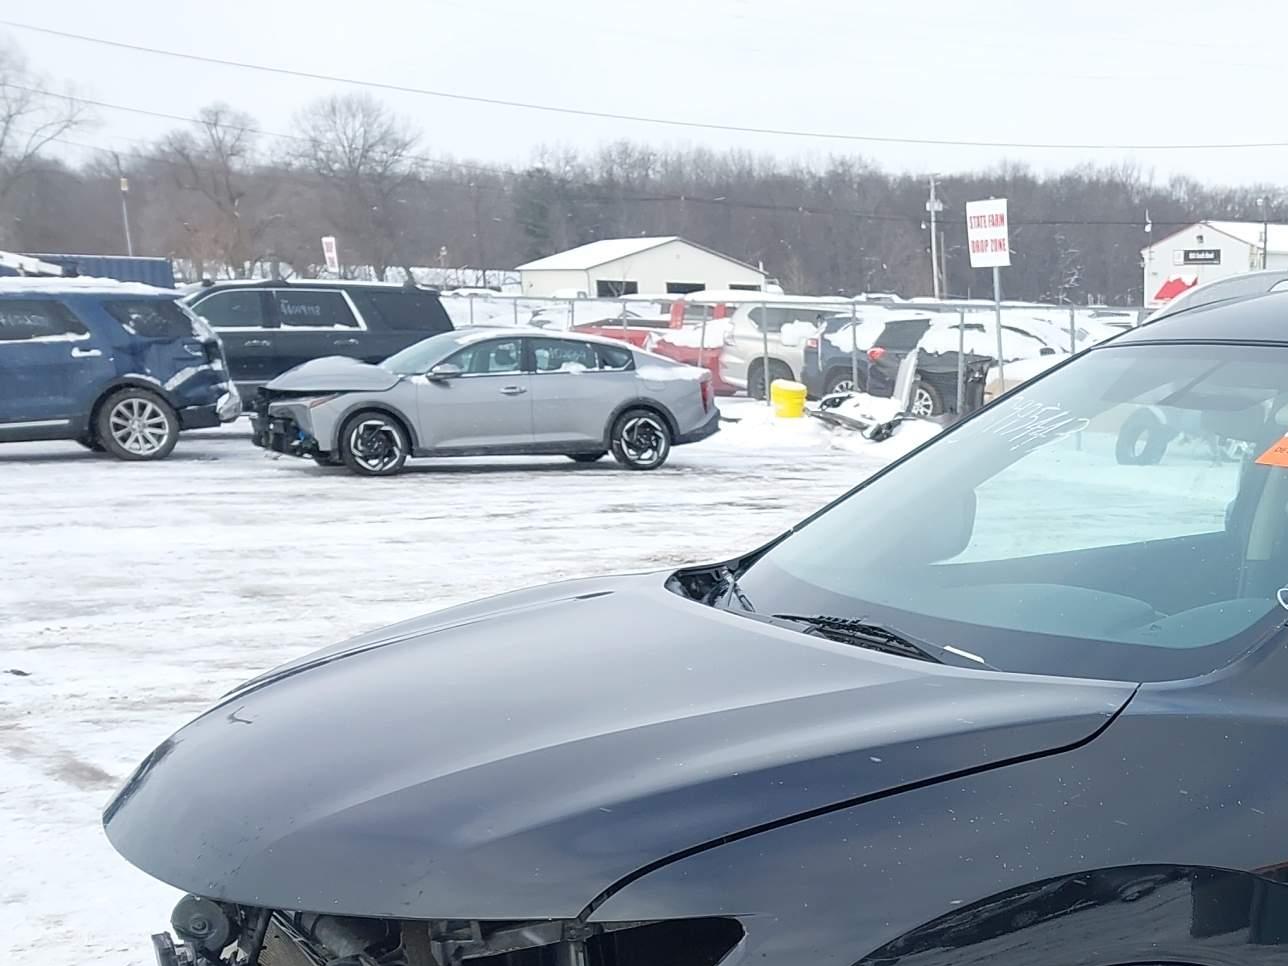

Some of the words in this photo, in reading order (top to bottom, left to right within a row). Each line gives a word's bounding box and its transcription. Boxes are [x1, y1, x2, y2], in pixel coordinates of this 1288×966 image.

[969, 215, 987, 229] STATE
[988, 213, 1005, 227] FARM
[970, 239, 988, 253] DROP
[990, 238, 1007, 252] ZONE
